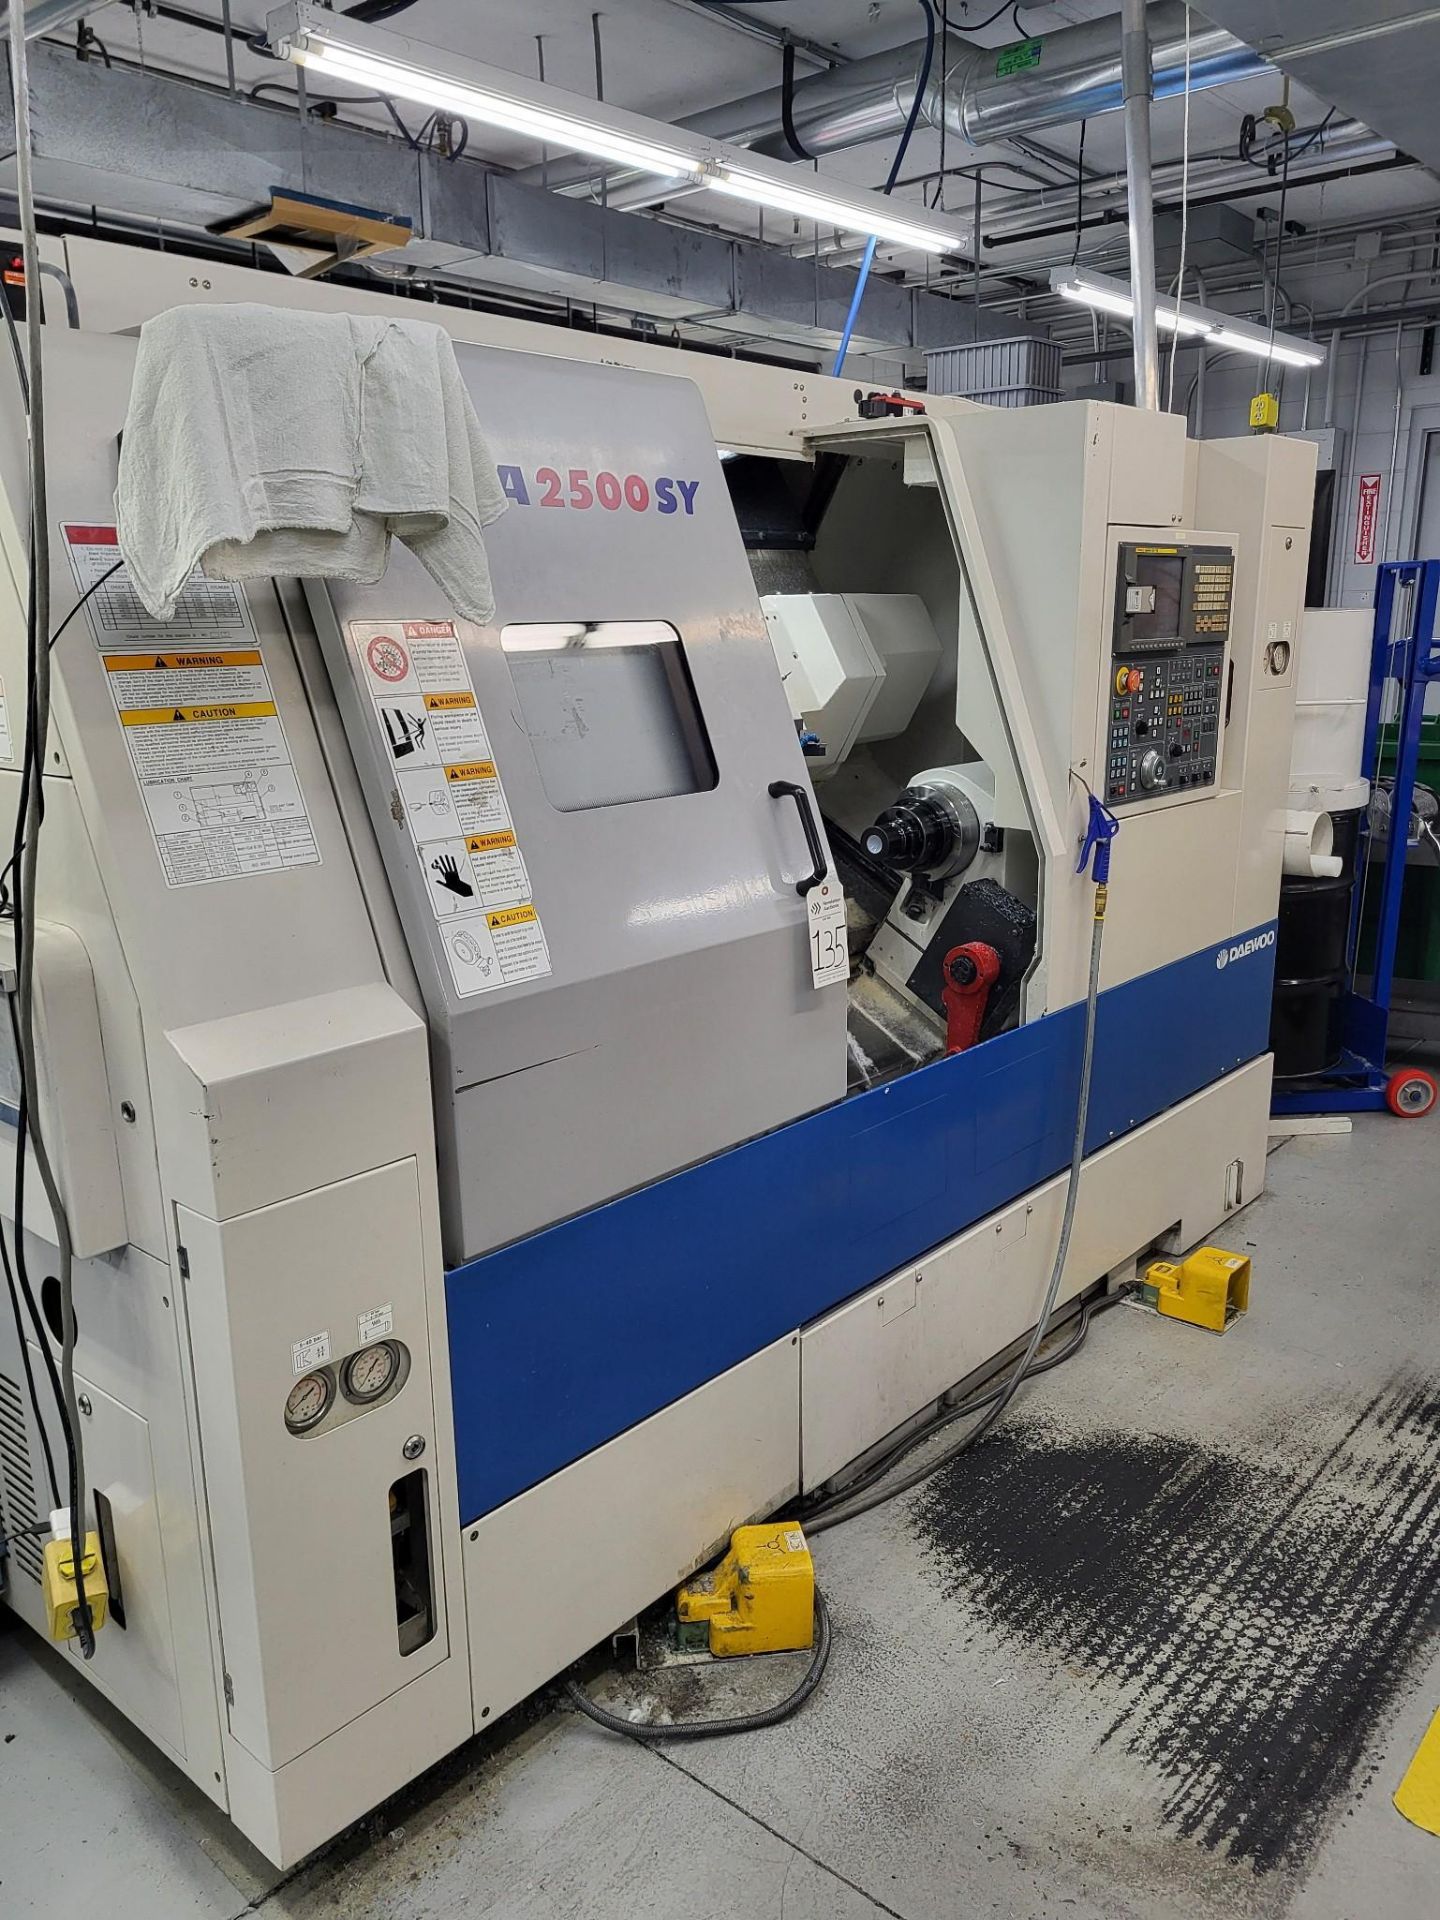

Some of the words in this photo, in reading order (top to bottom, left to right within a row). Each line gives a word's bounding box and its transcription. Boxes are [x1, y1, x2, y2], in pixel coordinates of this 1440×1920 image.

[1361, 495, 1372, 556] EXTINGUISHER
[419, 625, 452, 635] DANGER
[176, 656, 224, 667] WARNING
[438, 696, 472, 706] WARNING
[192, 707, 236, 719] CAUTION
[459, 766, 493, 777] WARNING
[480, 835, 513, 847] WARNING
[500, 910, 534, 923] CAUTION
[812, 924, 847, 972] 135
[1229, 930, 1275, 962] DAEWOO
